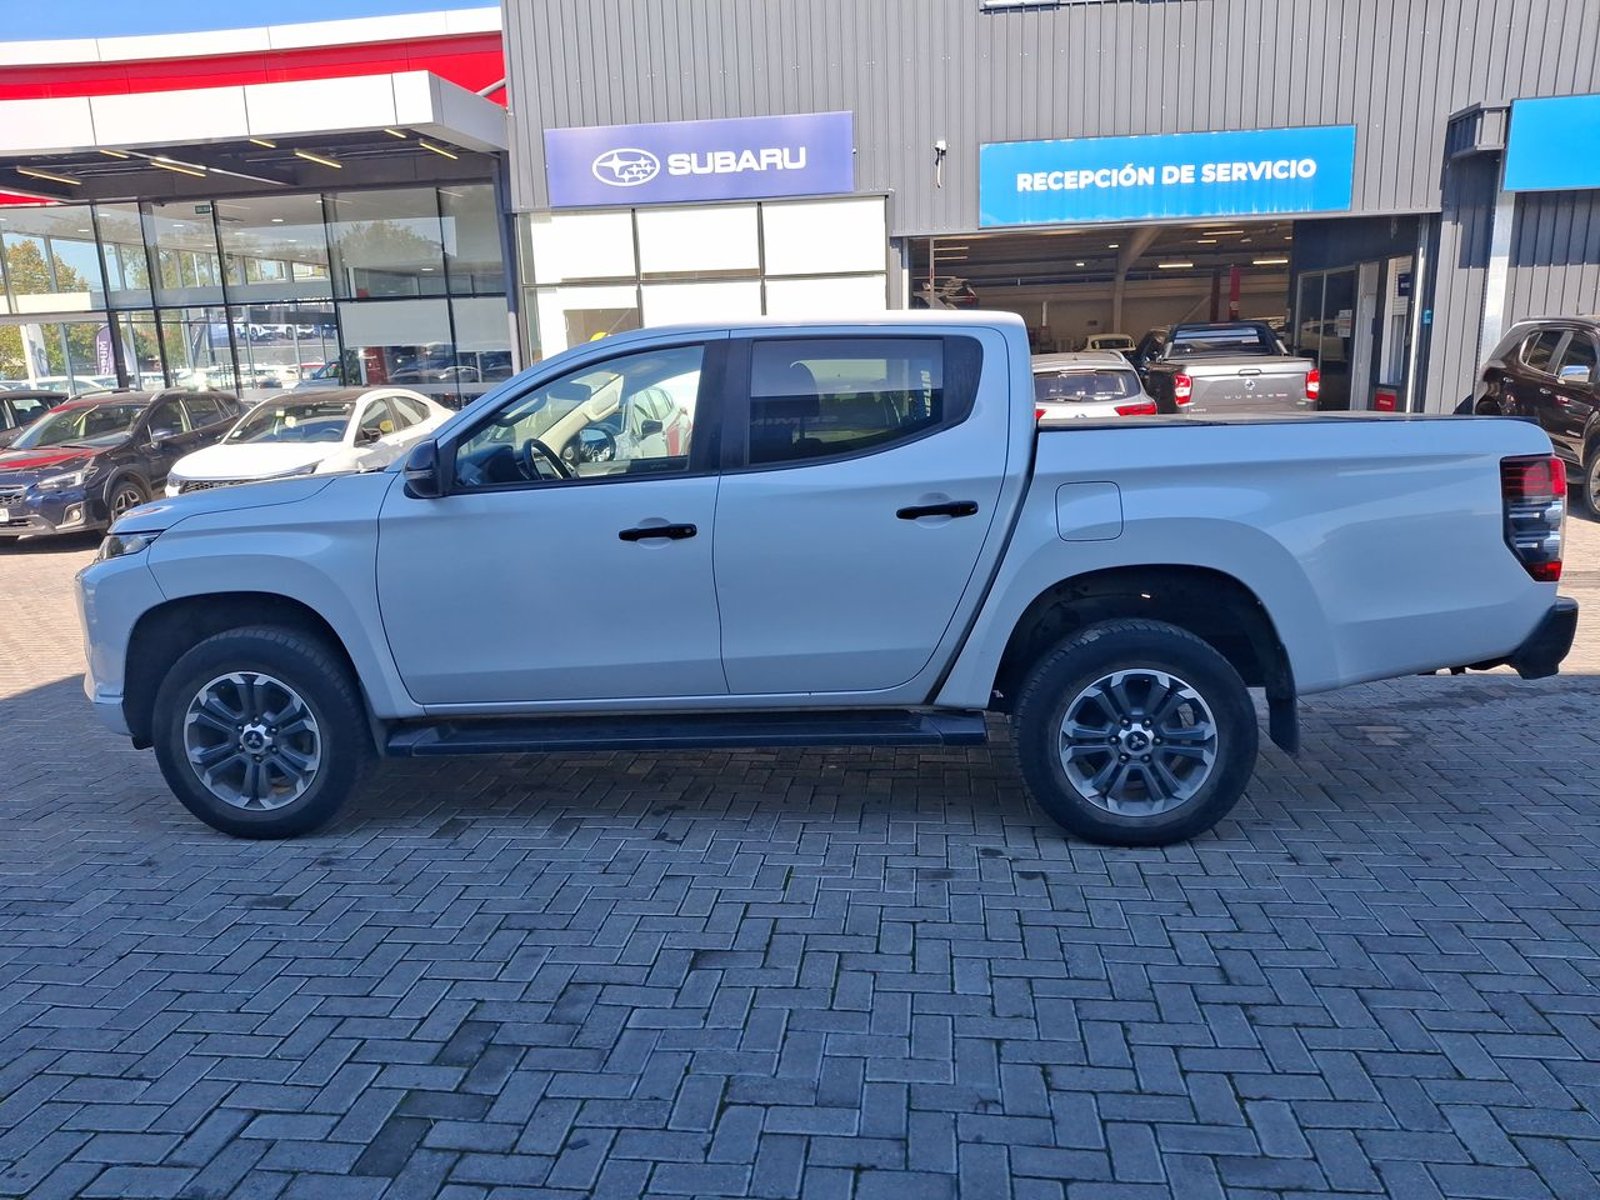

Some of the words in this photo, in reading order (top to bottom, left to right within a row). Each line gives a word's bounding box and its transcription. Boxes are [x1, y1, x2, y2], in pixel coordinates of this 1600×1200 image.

[668, 146, 807, 176] SUBARU
[1016, 163, 1155, 192] RECEPCIÓN
[1162, 164, 1196, 184] DE
[1201, 158, 1318, 183] SERVICIO
